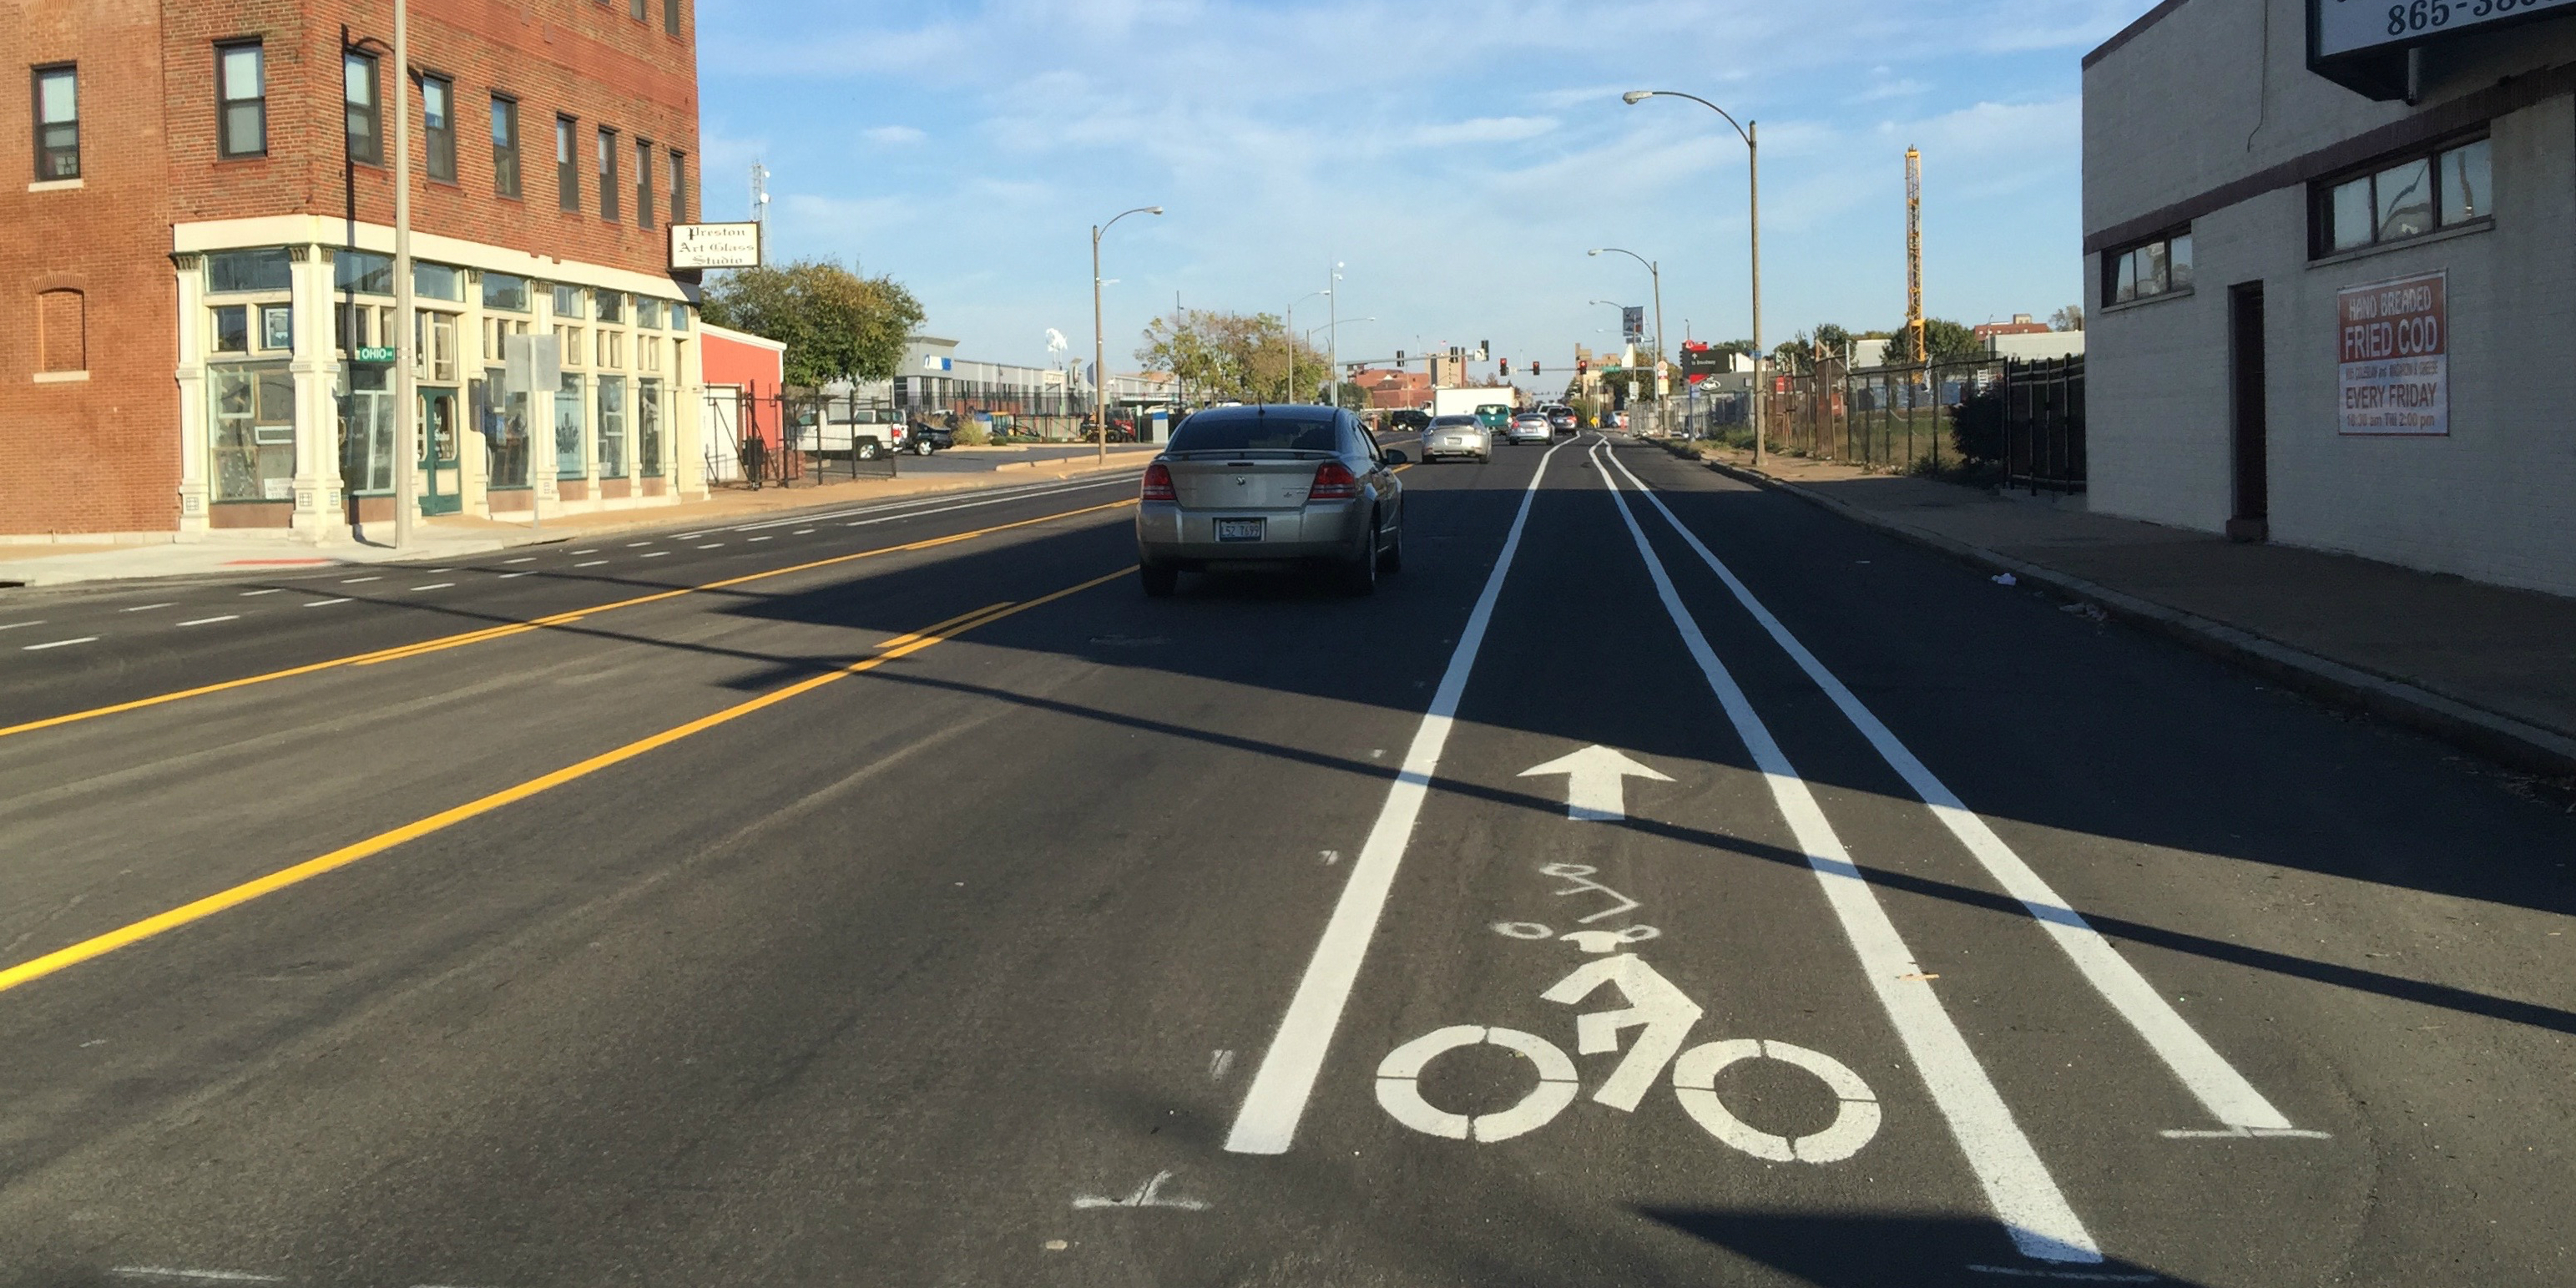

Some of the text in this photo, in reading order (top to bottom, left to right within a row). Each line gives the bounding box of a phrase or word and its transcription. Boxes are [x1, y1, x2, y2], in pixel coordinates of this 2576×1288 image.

[687, 227, 745, 240] Preston
[679, 242, 755, 253] Art Glass
[690, 255, 743, 265] Studio
[2349, 287, 2431, 320] HAND BREADED
[2344, 316, 2437, 360] FRIED COD
[361, 348, 386, 359] OHIO
[2346, 382, 2437, 409] EVERY FRIDAY
[2399, 412, 2417, 427] 2:00
[2420, 414, 2435, 429] pm
